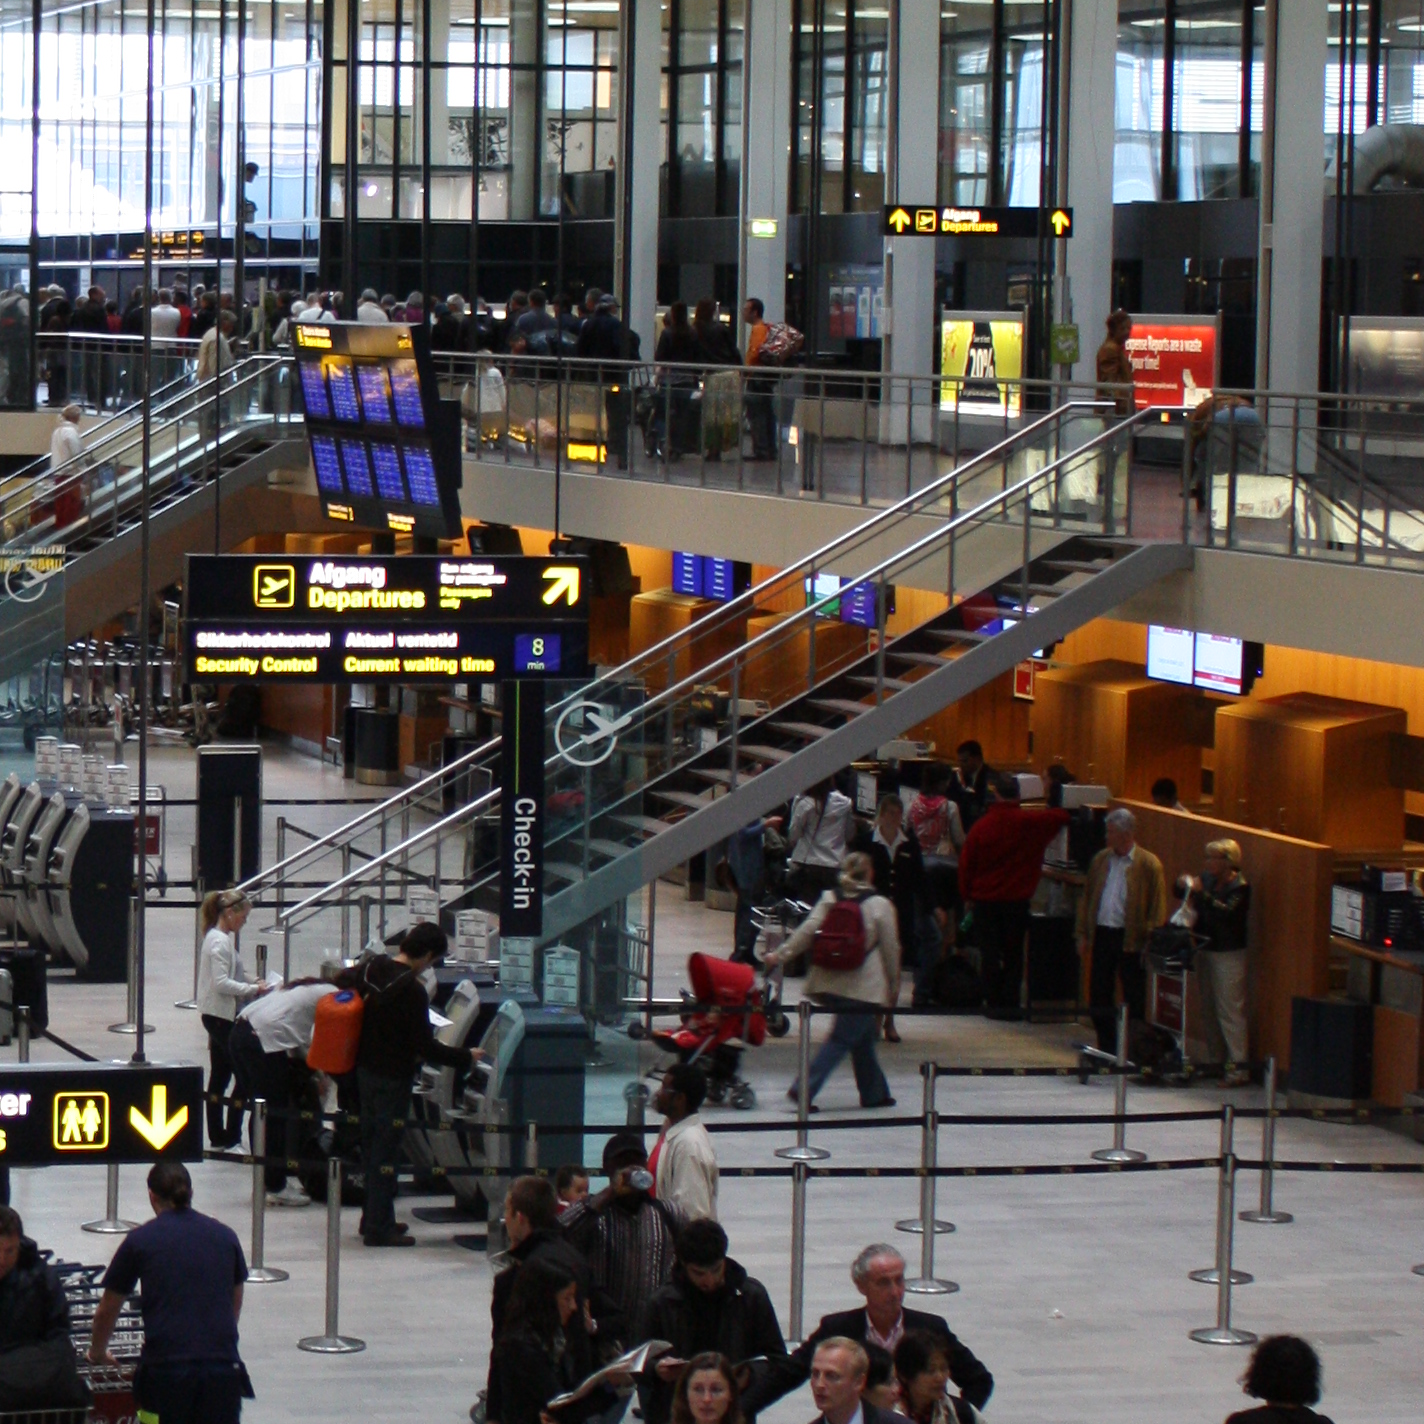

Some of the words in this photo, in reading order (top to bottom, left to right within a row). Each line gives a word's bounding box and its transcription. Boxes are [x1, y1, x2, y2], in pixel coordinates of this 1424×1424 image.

[941, 221, 998, 233] Departures
[970, 348, 995, 378] 20%
[309, 562, 387, 588] Afgang
[309, 586, 425, 612] Departures
[344, 631, 394, 649] Aktuel
[397, 631, 458, 649] ventetid
[531, 637, 544, 656] 8
[196, 656, 259, 675] Security
[262, 656, 318, 672] Control
[344, 656, 400, 672] Current
[403, 656, 459, 675] waiting
[461, 656, 495, 672] time
[526, 661, 545, 670] min
[513, 797, 536, 909] Check-in
